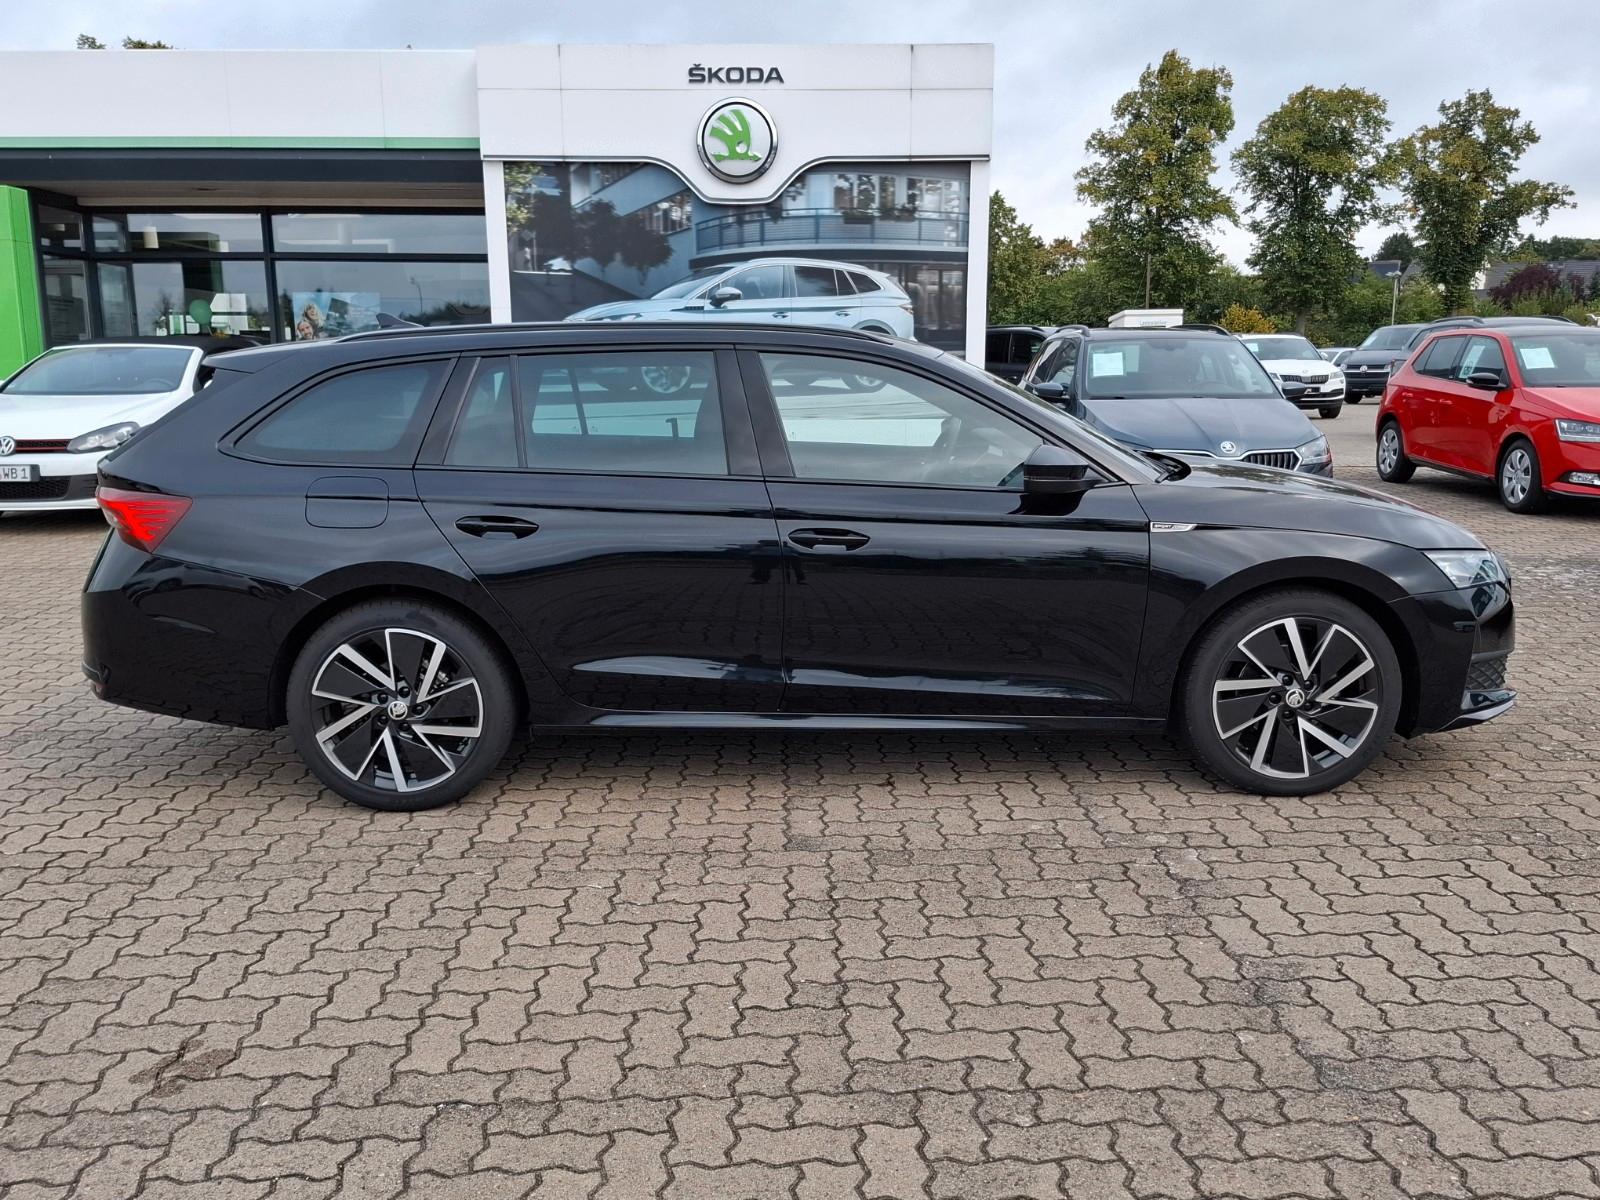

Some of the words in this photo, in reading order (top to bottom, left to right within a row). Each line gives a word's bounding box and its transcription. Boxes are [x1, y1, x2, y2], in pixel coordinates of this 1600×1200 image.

[688, 63, 785, 84] ŠKODA
[3, 467, 18, 480] WB
[20, 467, 28, 480] 1
